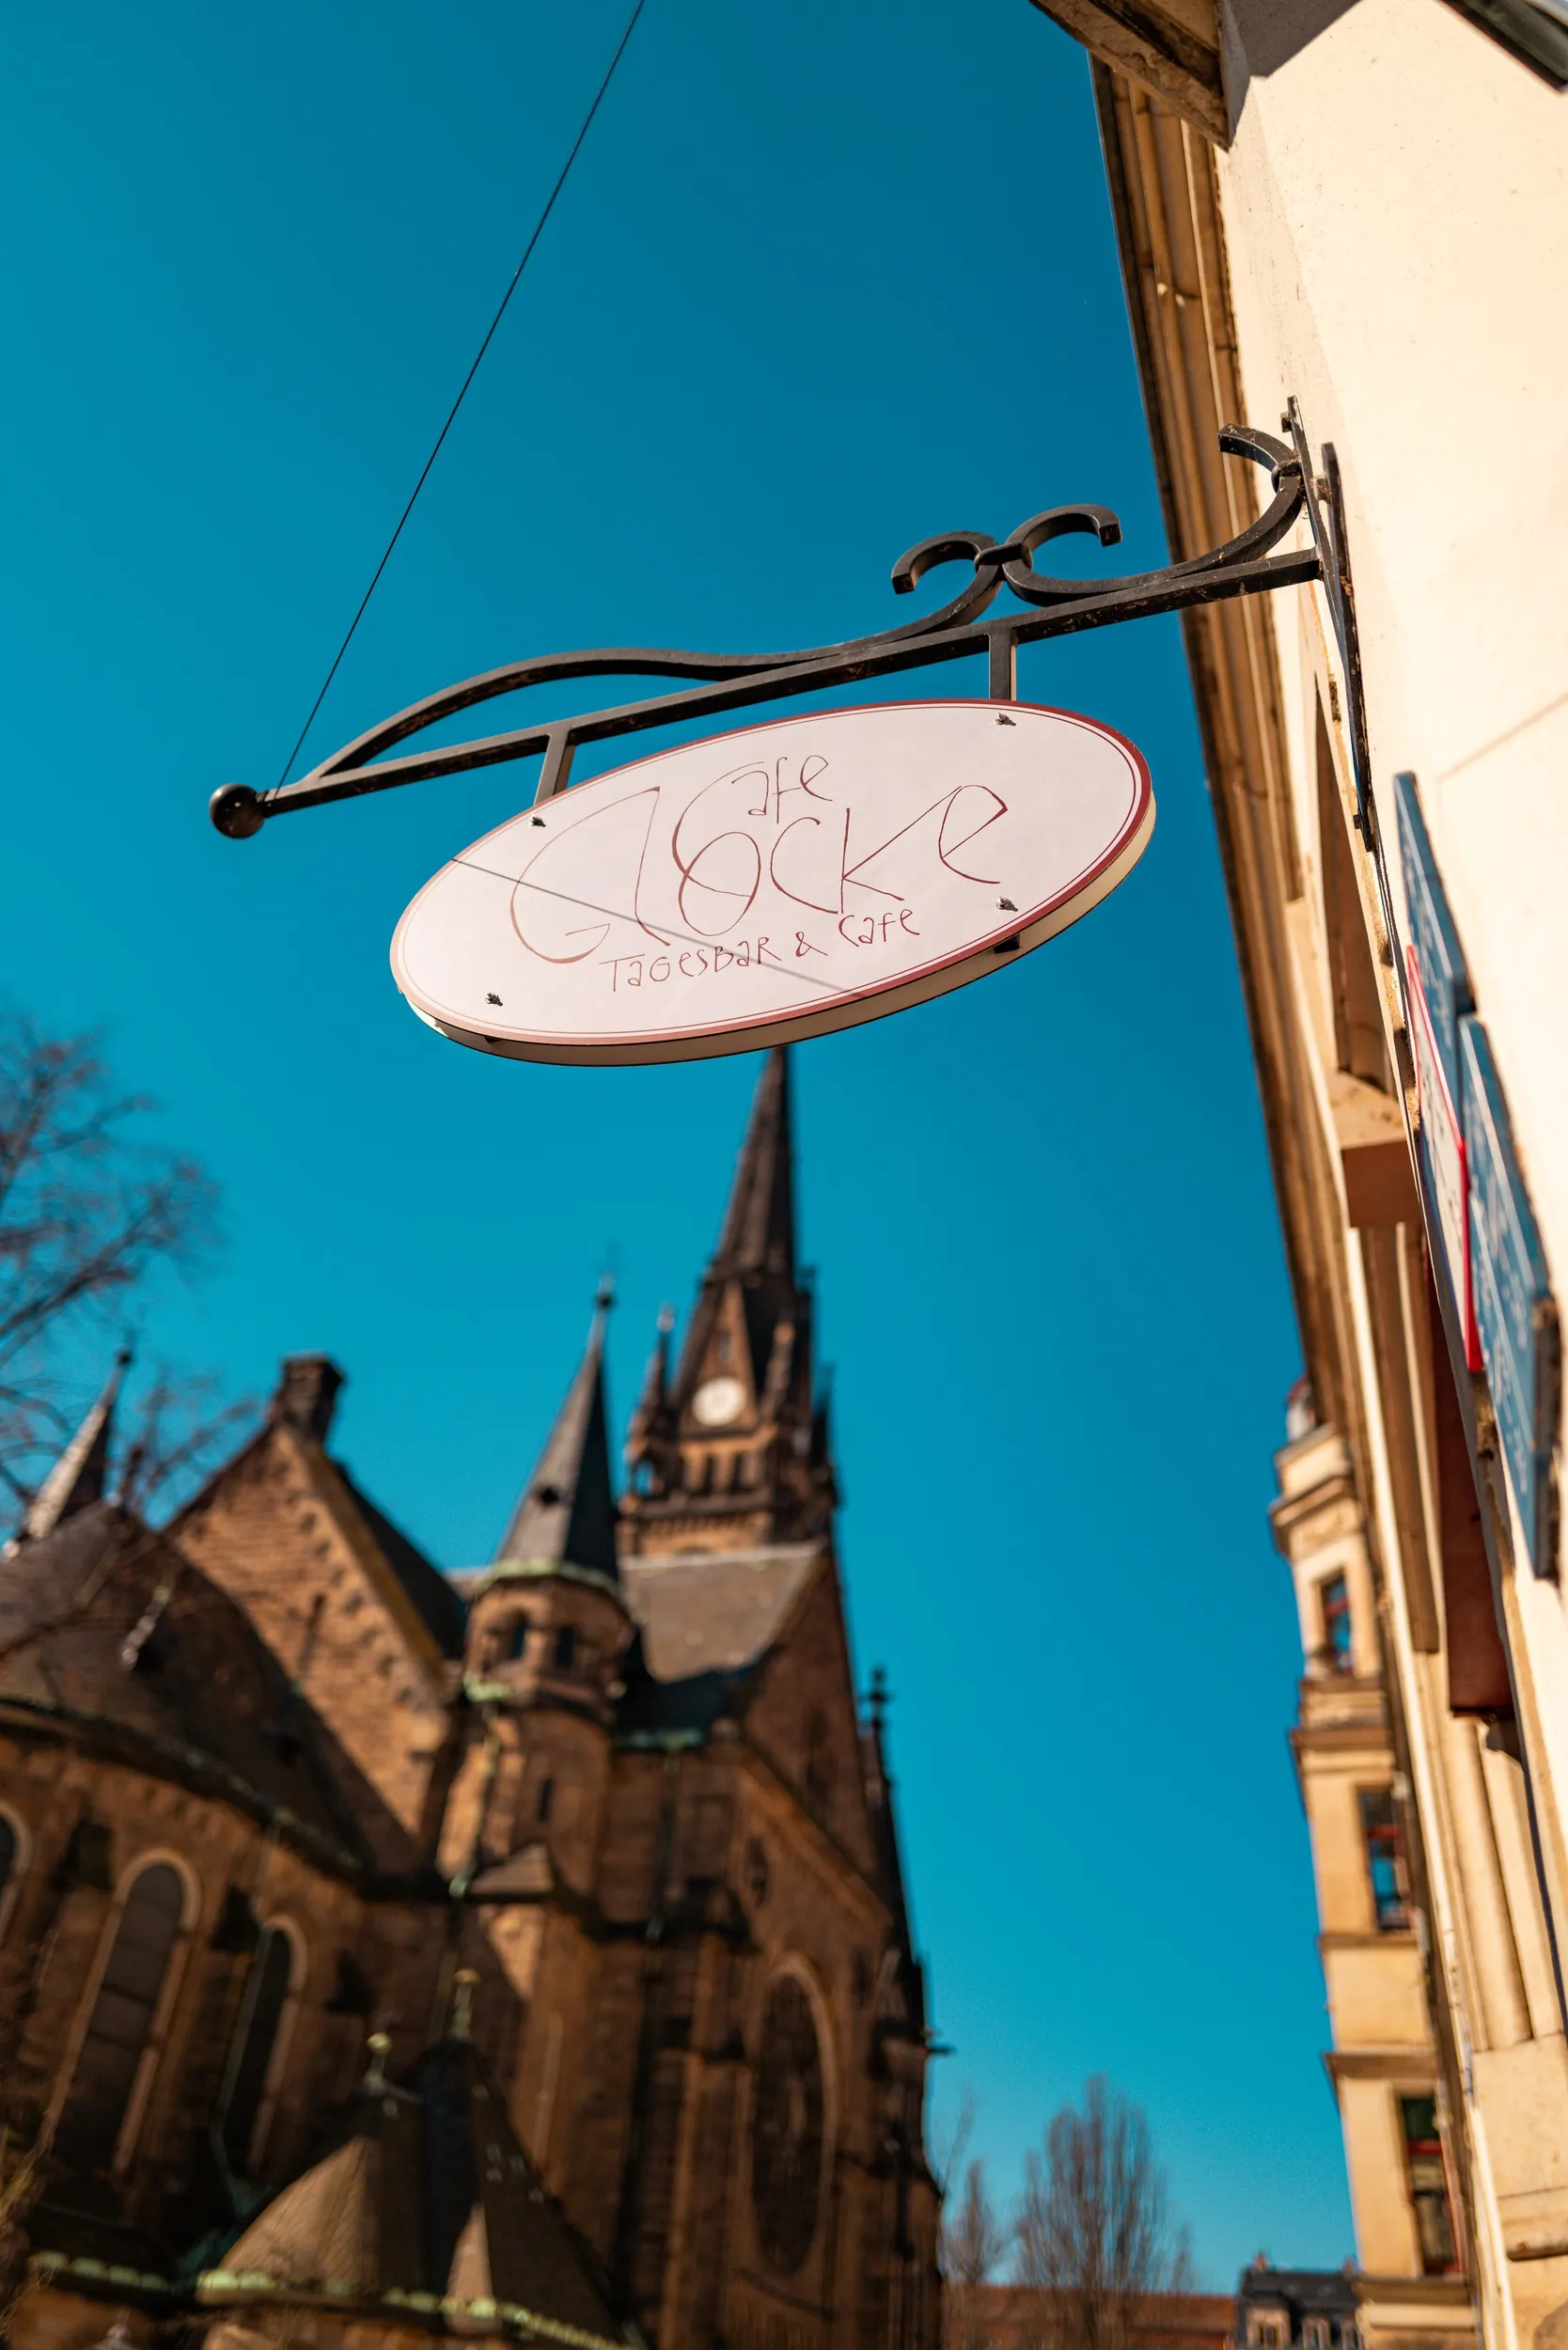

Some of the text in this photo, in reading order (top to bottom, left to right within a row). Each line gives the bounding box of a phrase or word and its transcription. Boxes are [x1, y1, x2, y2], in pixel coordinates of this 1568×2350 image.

[672, 755, 833, 898] Cafe
[794, 932, 828, 957] &
[838, 908, 921, 948] Cafe
